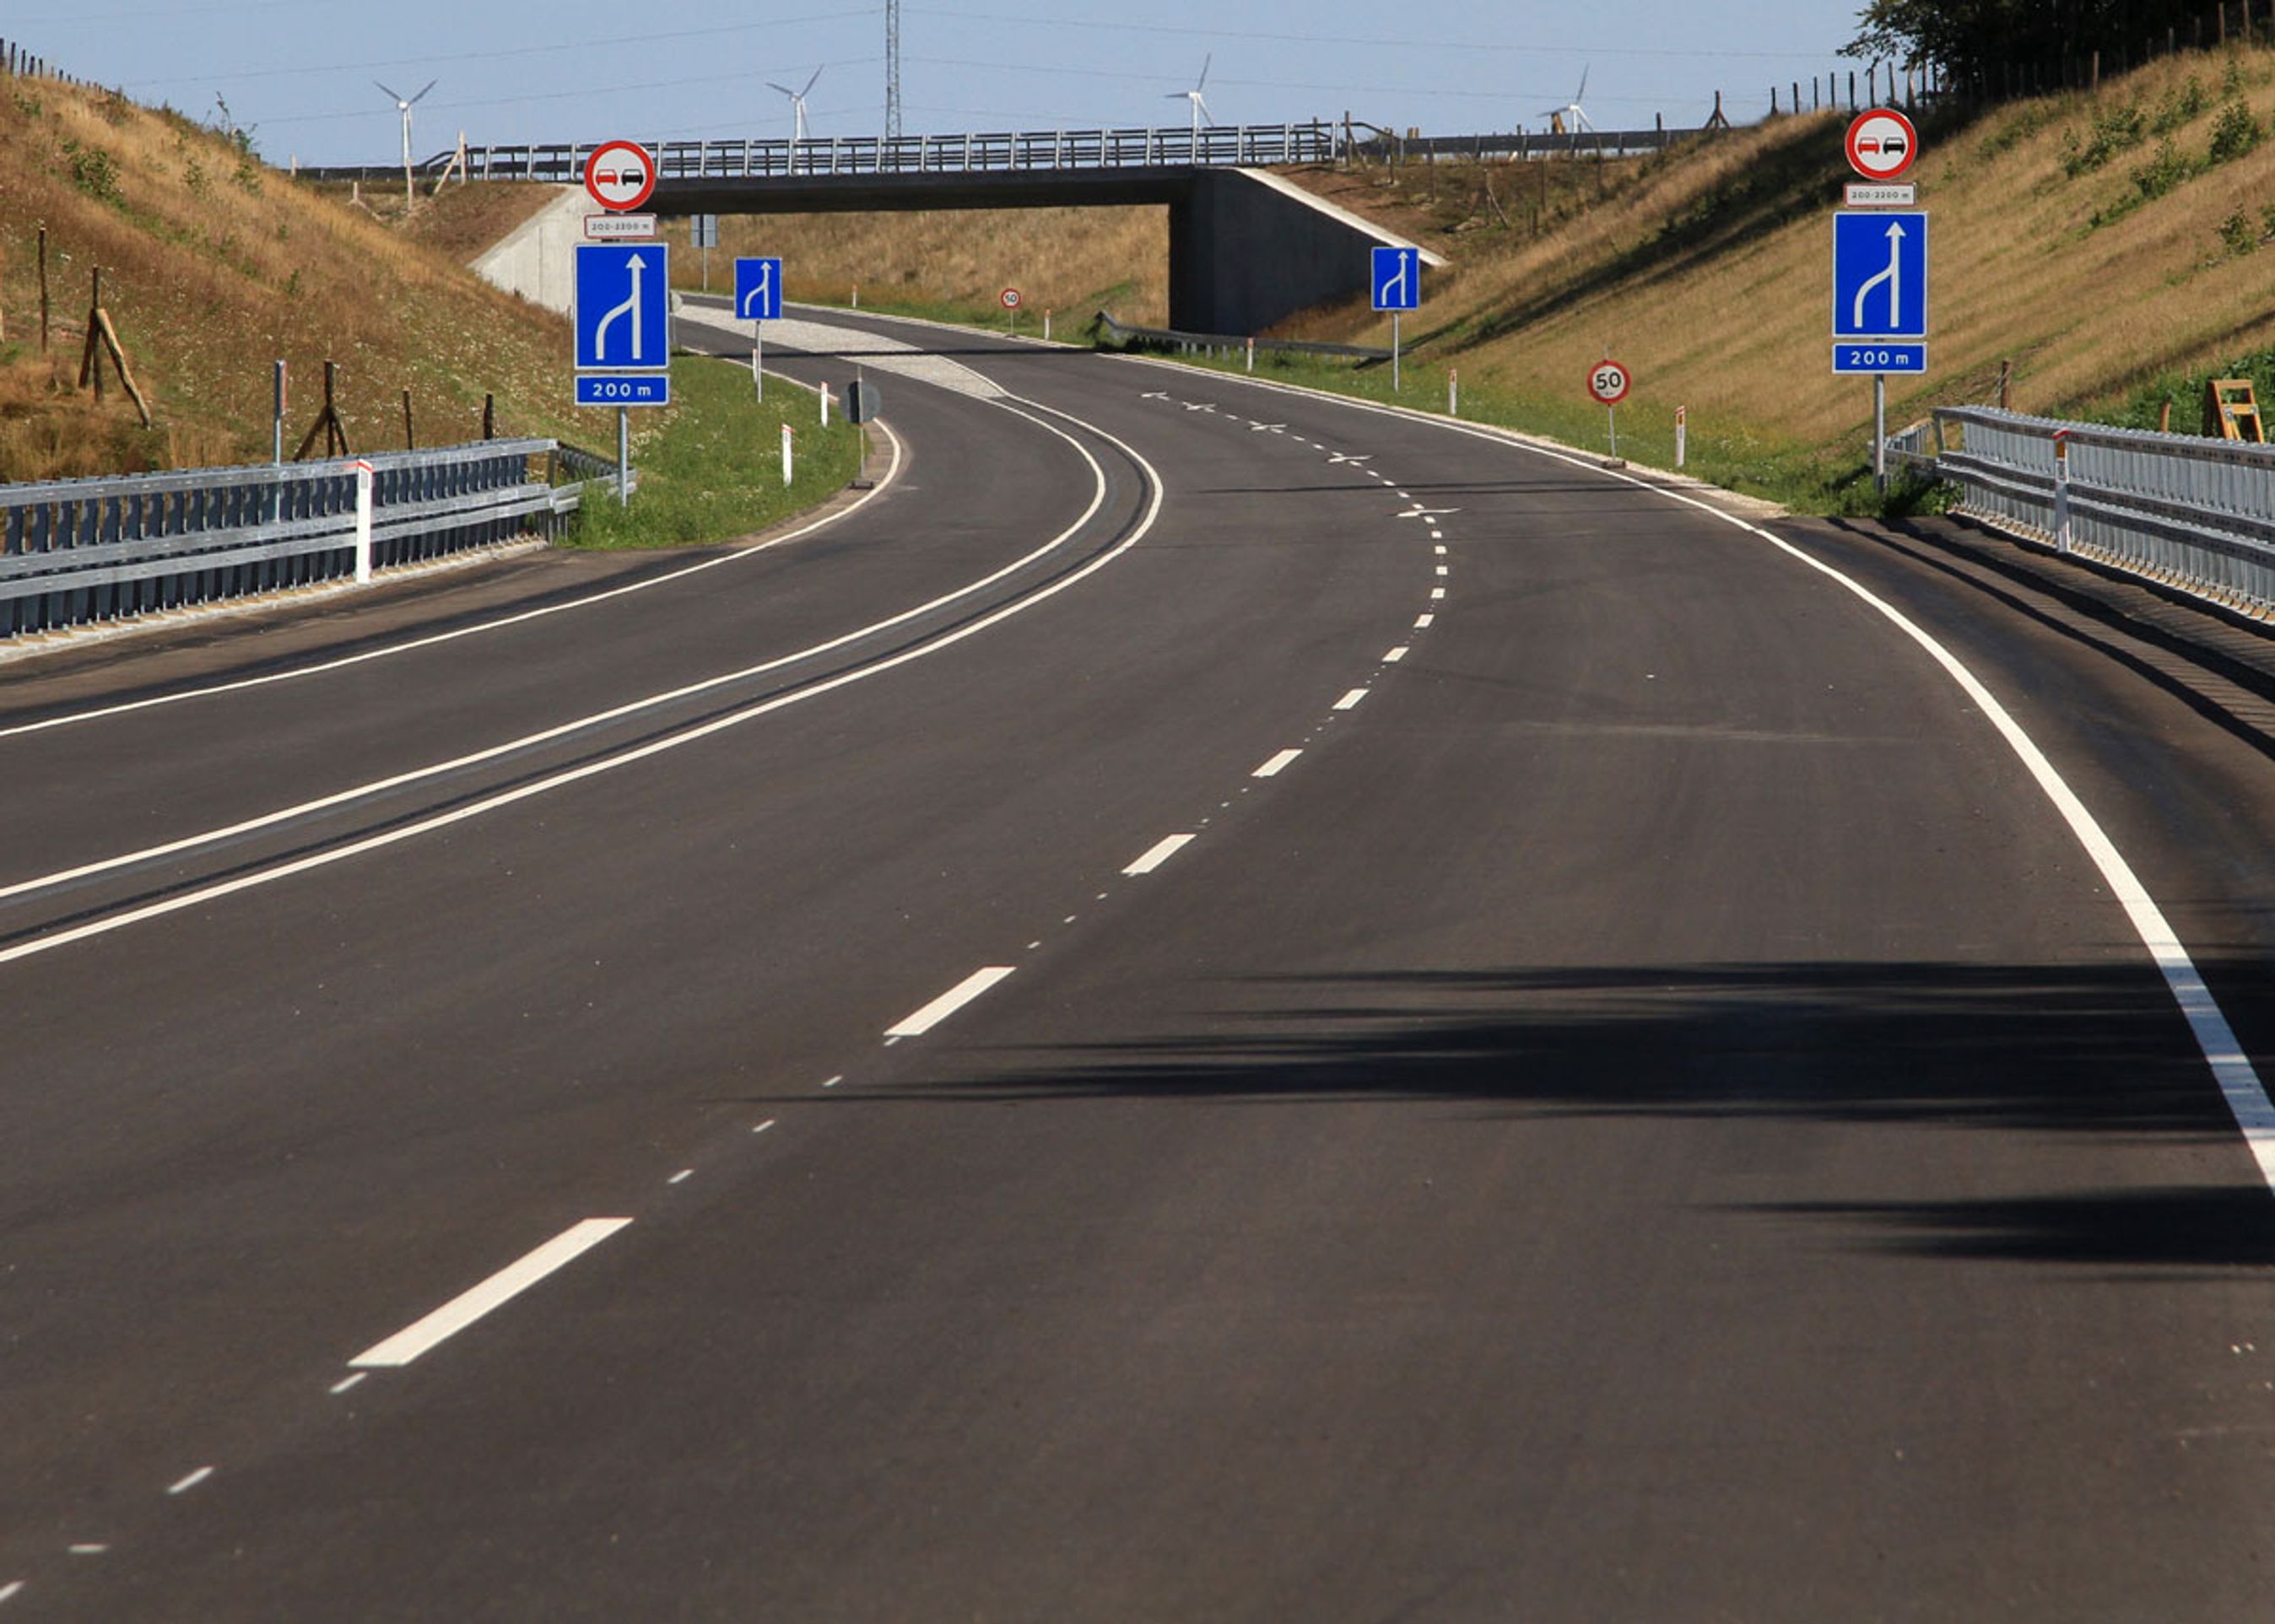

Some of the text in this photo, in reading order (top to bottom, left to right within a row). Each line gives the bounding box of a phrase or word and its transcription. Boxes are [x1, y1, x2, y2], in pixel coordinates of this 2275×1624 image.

[1851, 351, 1909, 364] 200 m
[1597, 372, 1621, 390] 50
[593, 383, 651, 397] 200 m
